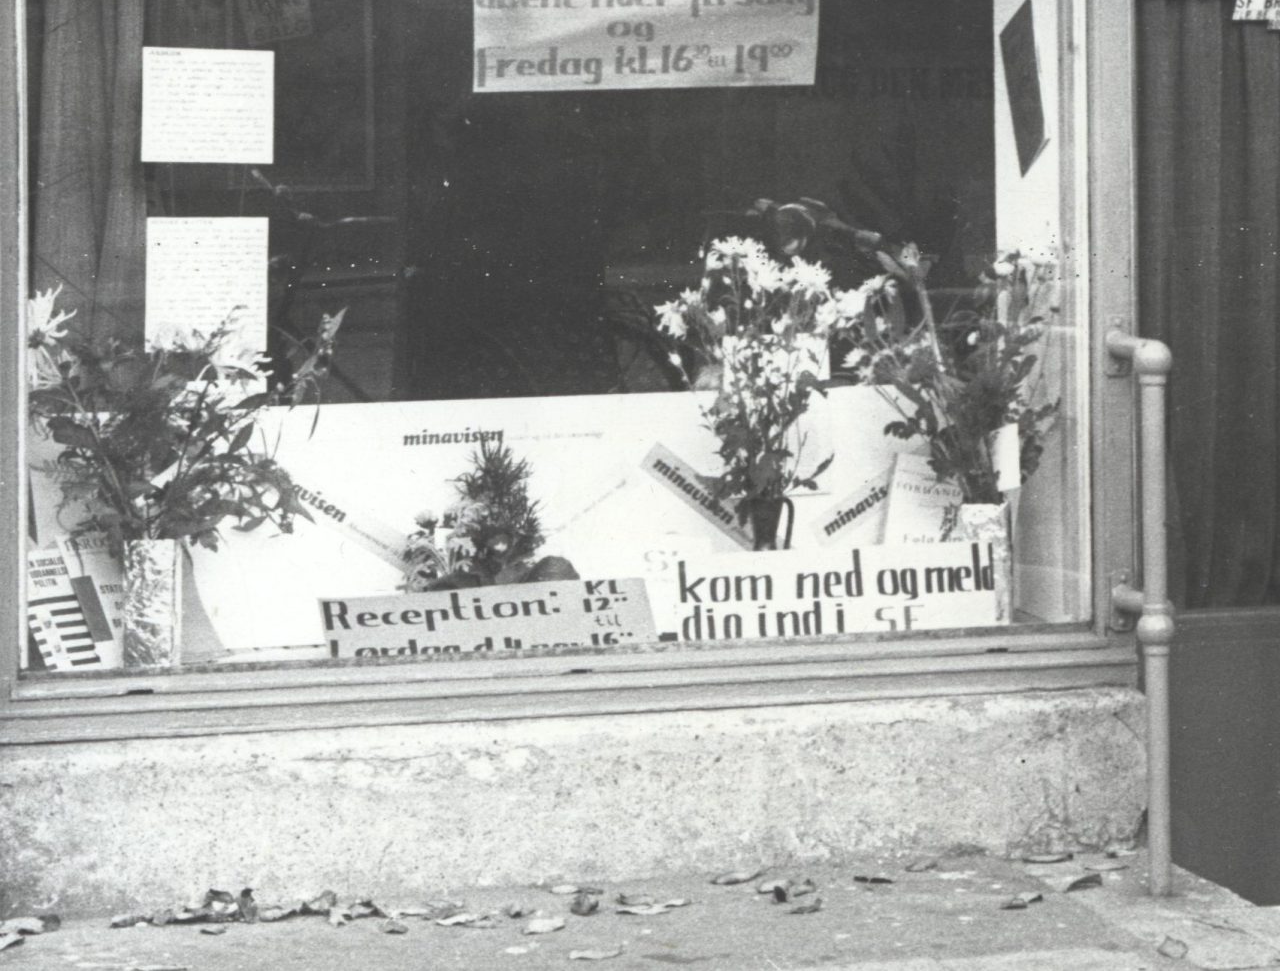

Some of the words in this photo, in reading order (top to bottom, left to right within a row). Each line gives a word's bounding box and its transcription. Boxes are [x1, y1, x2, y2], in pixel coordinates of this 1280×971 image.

[606, 19, 655, 43] og
[824, 486, 889, 537] minavis
[584, 579, 627, 596] KL
[678, 560, 775, 605] kom
[795, 548, 864, 600] ned
[876, 568, 919, 601] og
[925, 542, 995, 595] meld
[594, 614, 622, 627] til
[757, 600, 822, 638] ind
[835, 602, 845, 635] i
